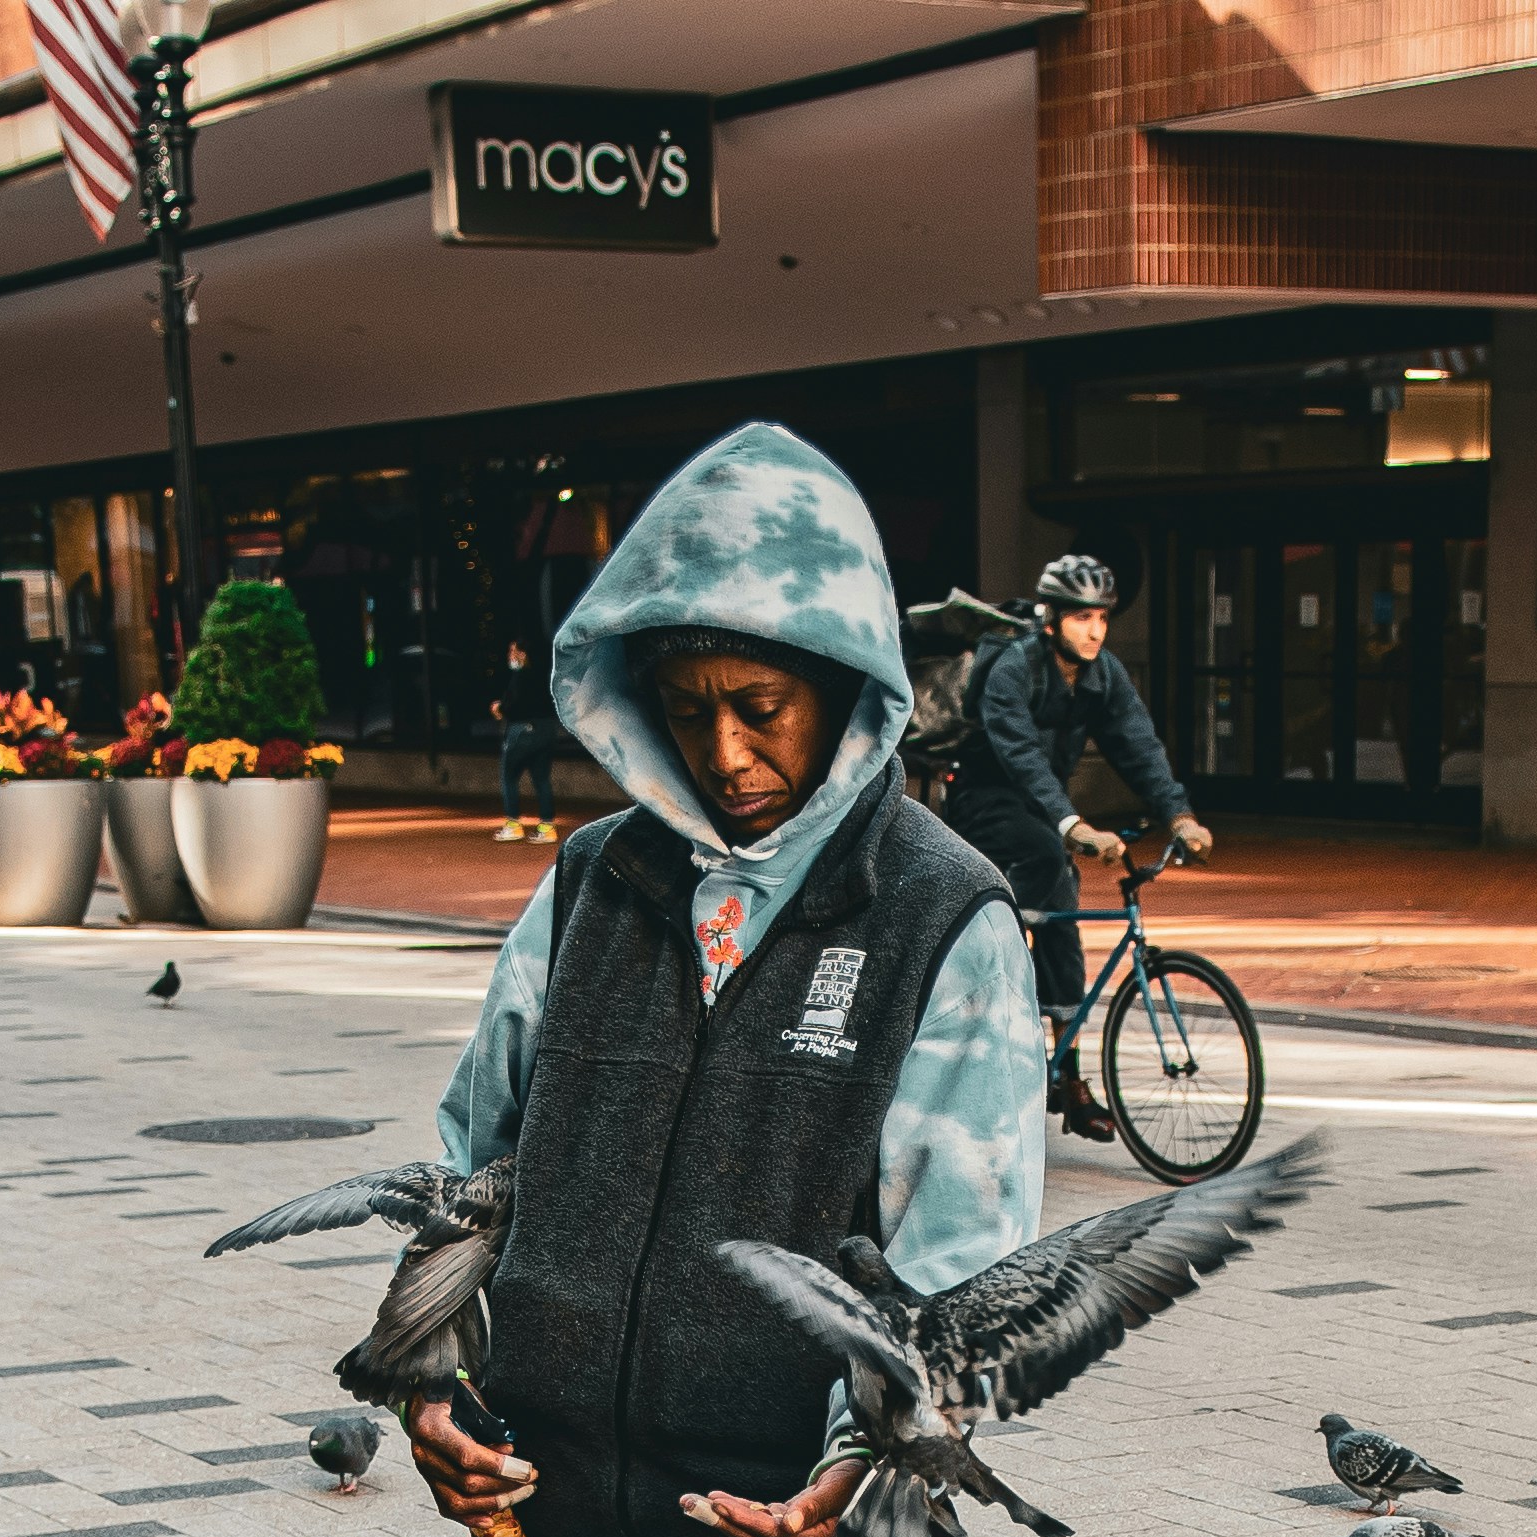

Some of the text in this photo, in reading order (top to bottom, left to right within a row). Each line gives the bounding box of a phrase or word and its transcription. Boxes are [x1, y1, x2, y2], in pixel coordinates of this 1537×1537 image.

[475, 128, 690, 210] macy's
[817, 961, 863, 978] TRUST
[810, 980, 857, 997] PUBLIC
[804, 991, 854, 1009] LAND
[781, 1029, 858, 1052] Conserving Land
[790, 1041, 839, 1058] for People
